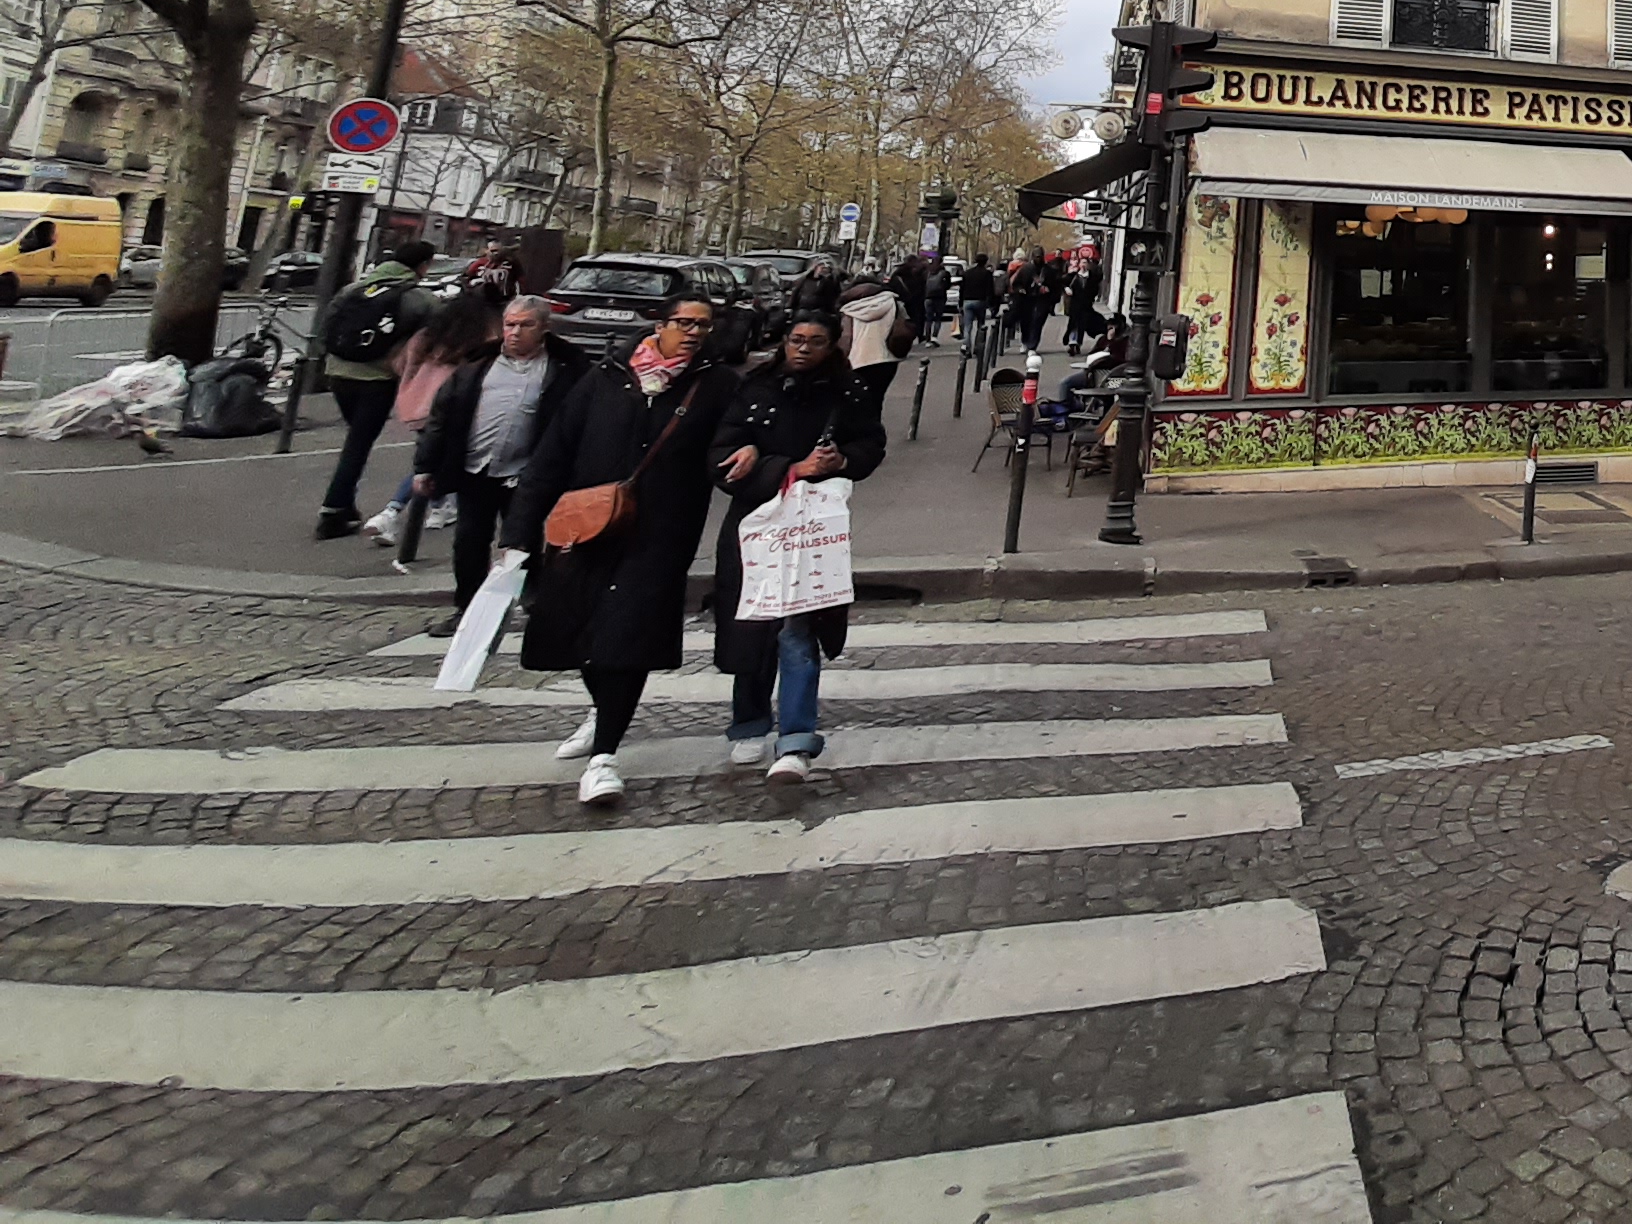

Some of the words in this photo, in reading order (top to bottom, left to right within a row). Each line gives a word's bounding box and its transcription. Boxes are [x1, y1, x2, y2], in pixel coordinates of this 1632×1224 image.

[1221, 69, 1491, 117] BOULANGERIE
[1370, 191, 1430, 205] MAISON
[1434, 194, 1524, 209] LANDEMAINE
